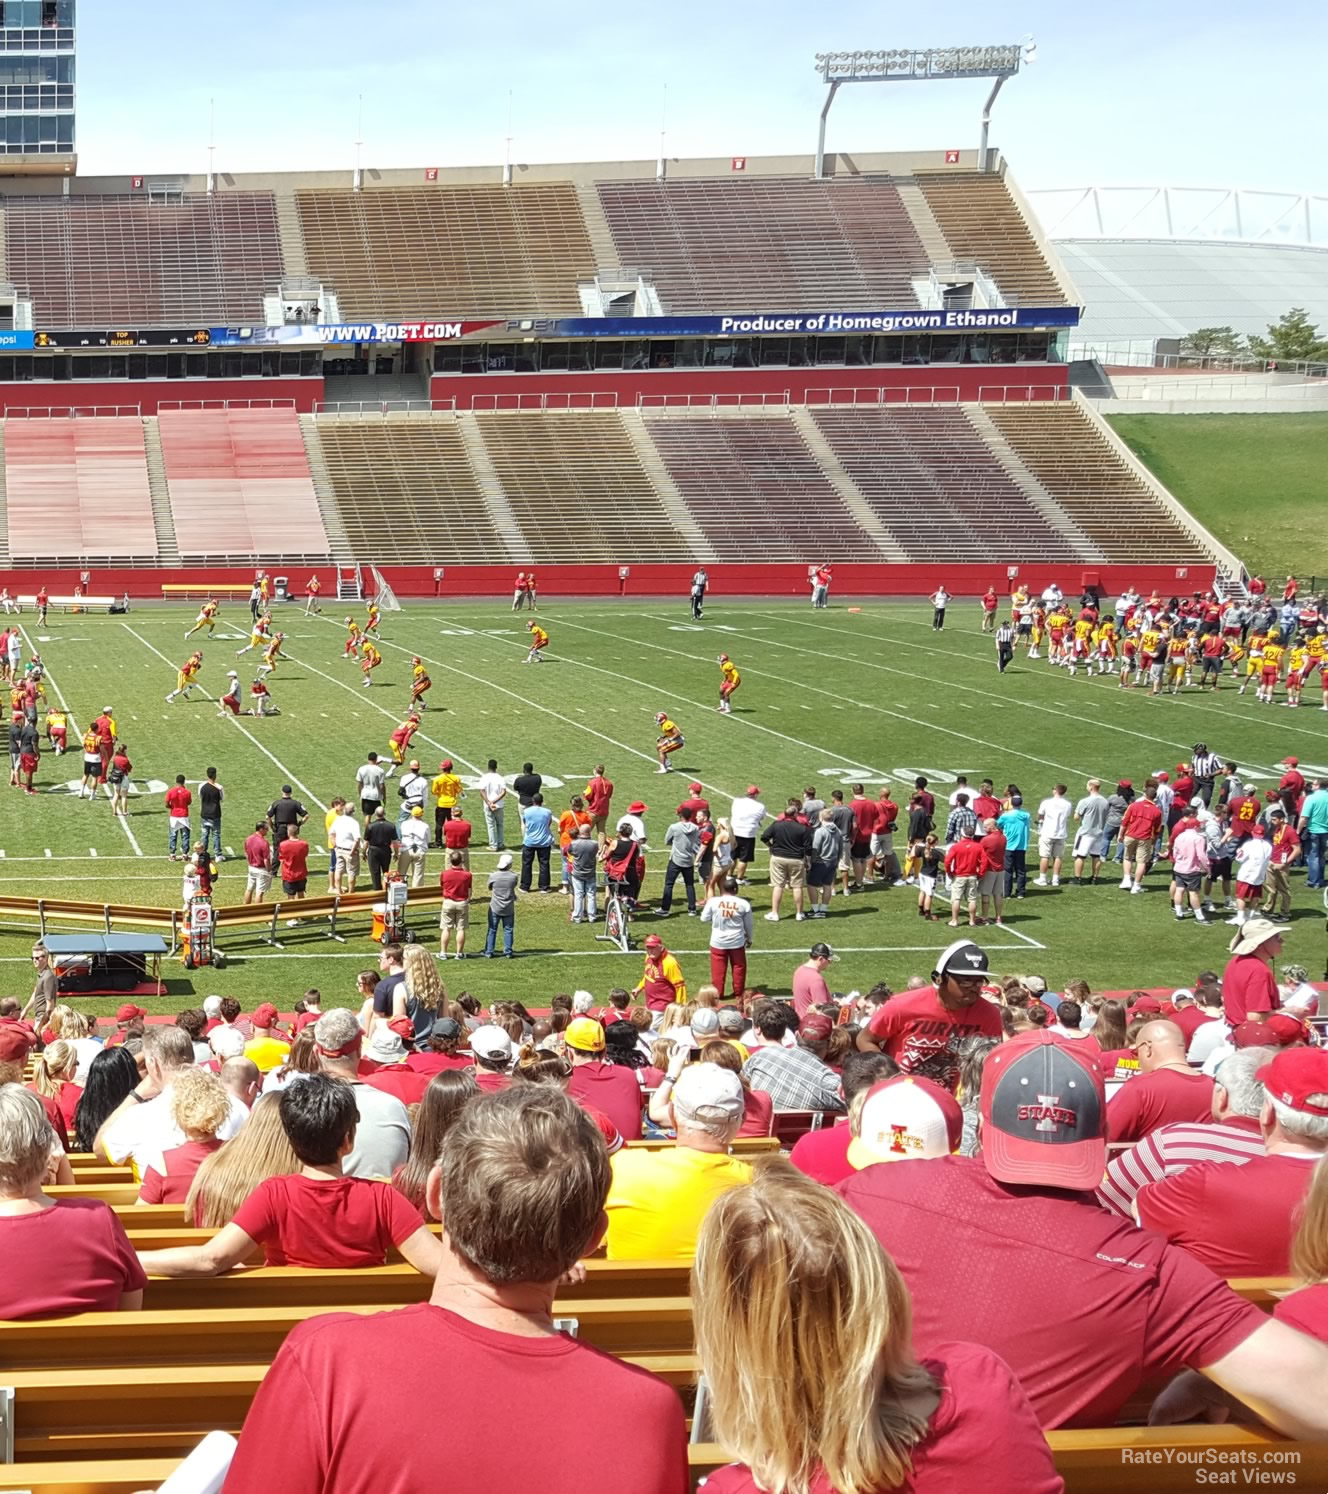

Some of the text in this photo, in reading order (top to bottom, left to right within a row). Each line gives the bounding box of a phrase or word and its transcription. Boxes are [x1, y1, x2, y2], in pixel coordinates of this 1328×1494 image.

[722, 311, 1018, 331] Producer of Homegrown Ethanol
[321, 322, 462, 341] WWW.POET.COM
[1239, 807, 1254, 820] 23
[719, 901, 739, 911] ALL
[722, 910, 734, 918] IN
[1017, 1104, 1077, 1129] STATE
[877, 1131, 924, 1152] STATE
